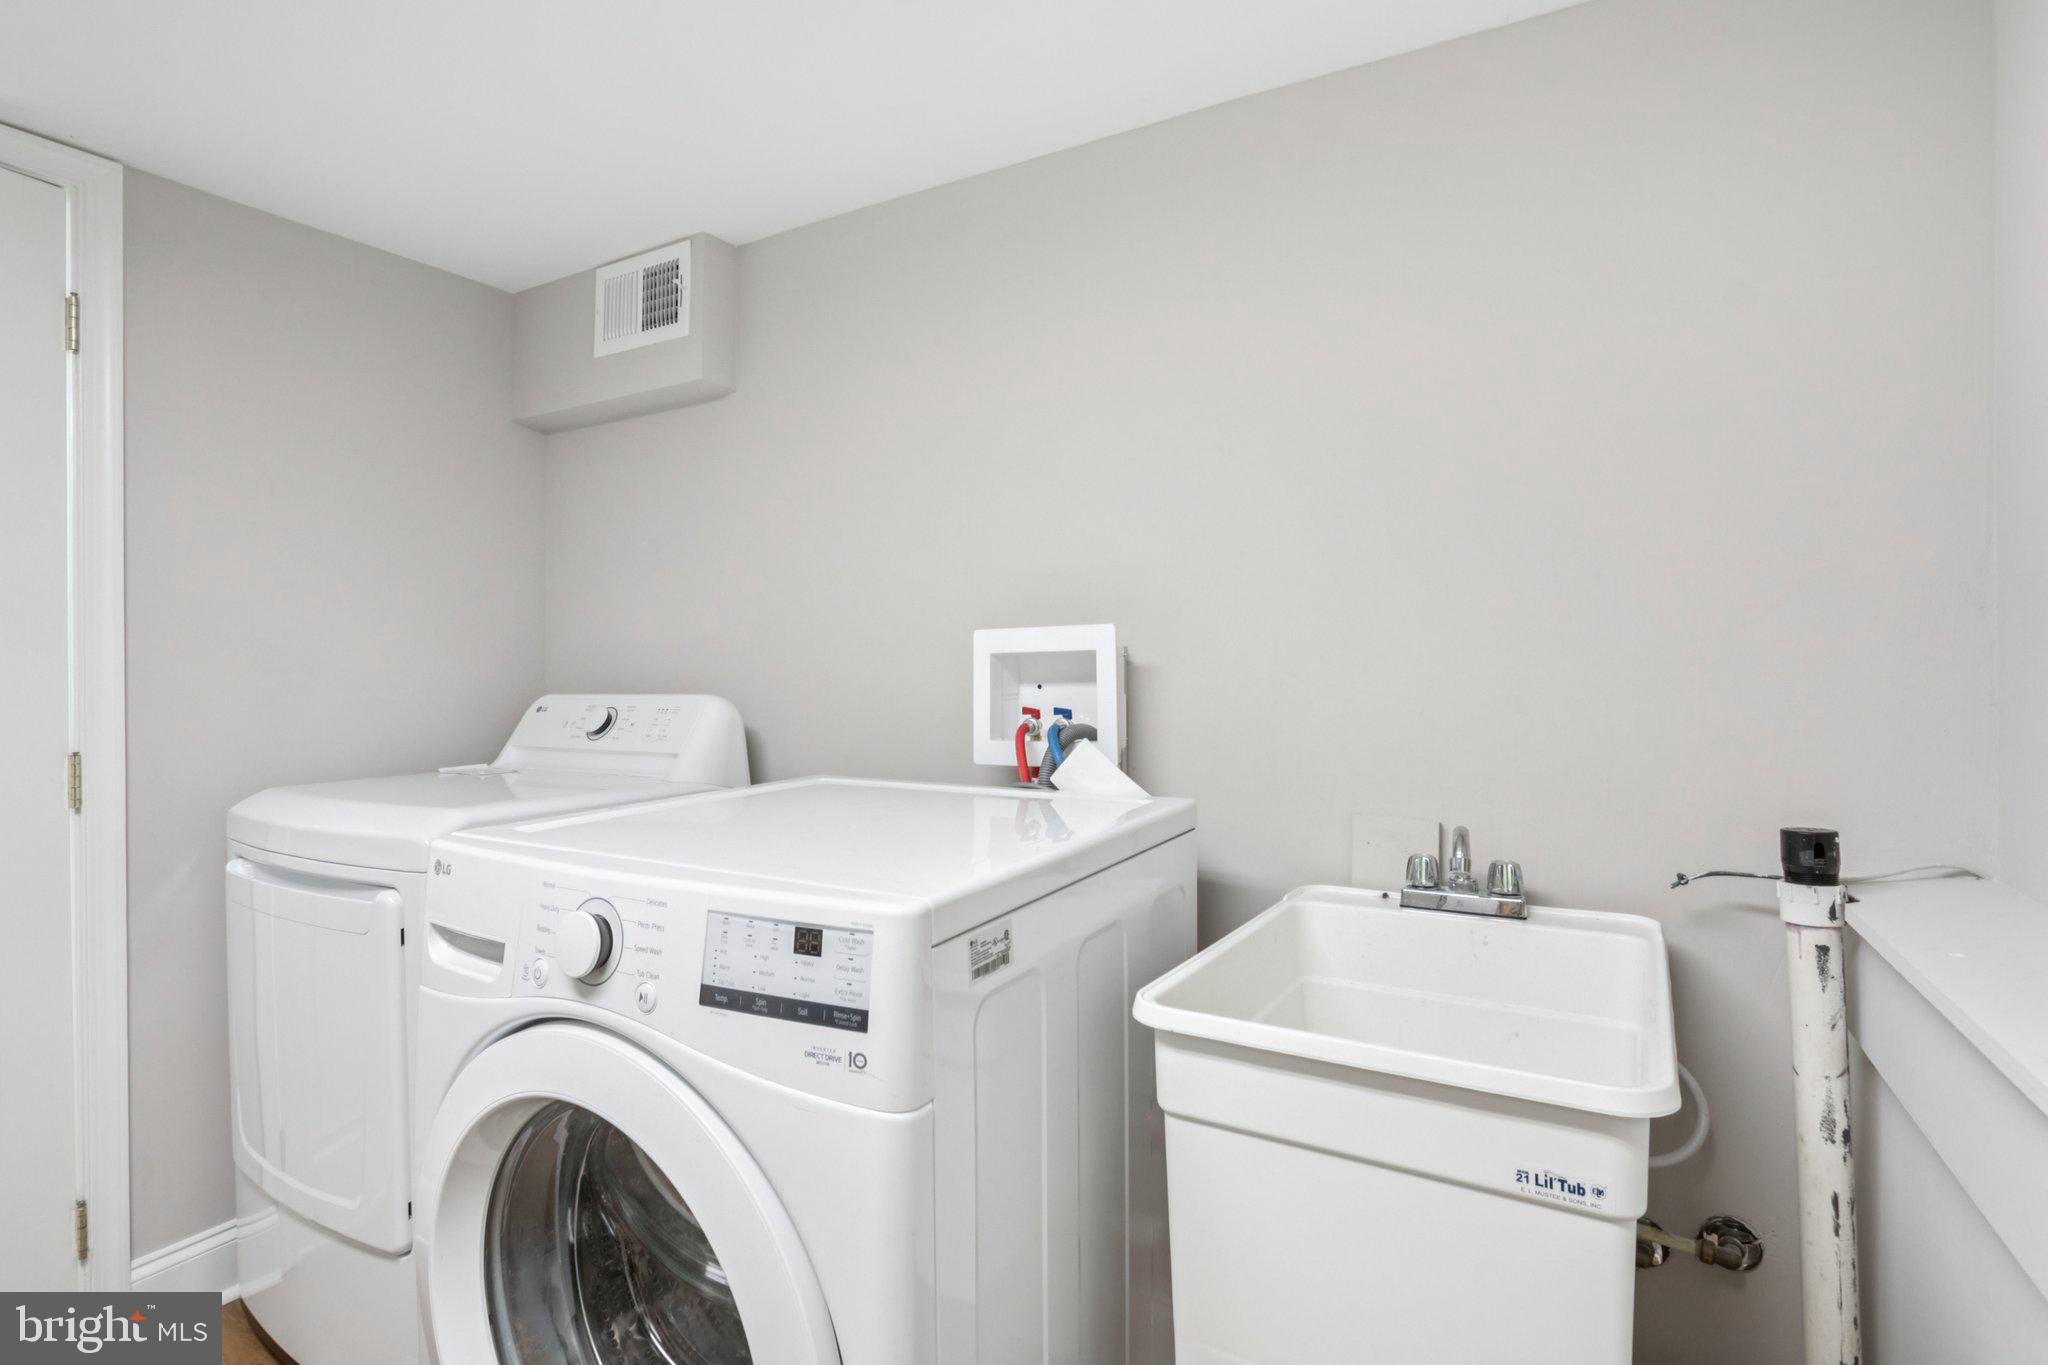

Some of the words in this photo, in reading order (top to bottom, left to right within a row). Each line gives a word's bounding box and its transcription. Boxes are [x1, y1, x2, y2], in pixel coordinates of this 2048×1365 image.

[804, 1050, 824, 1061] DIRECT
[824, 1053, 843, 1065] DRIVE
[1515, 1173, 1530, 1185] 21
